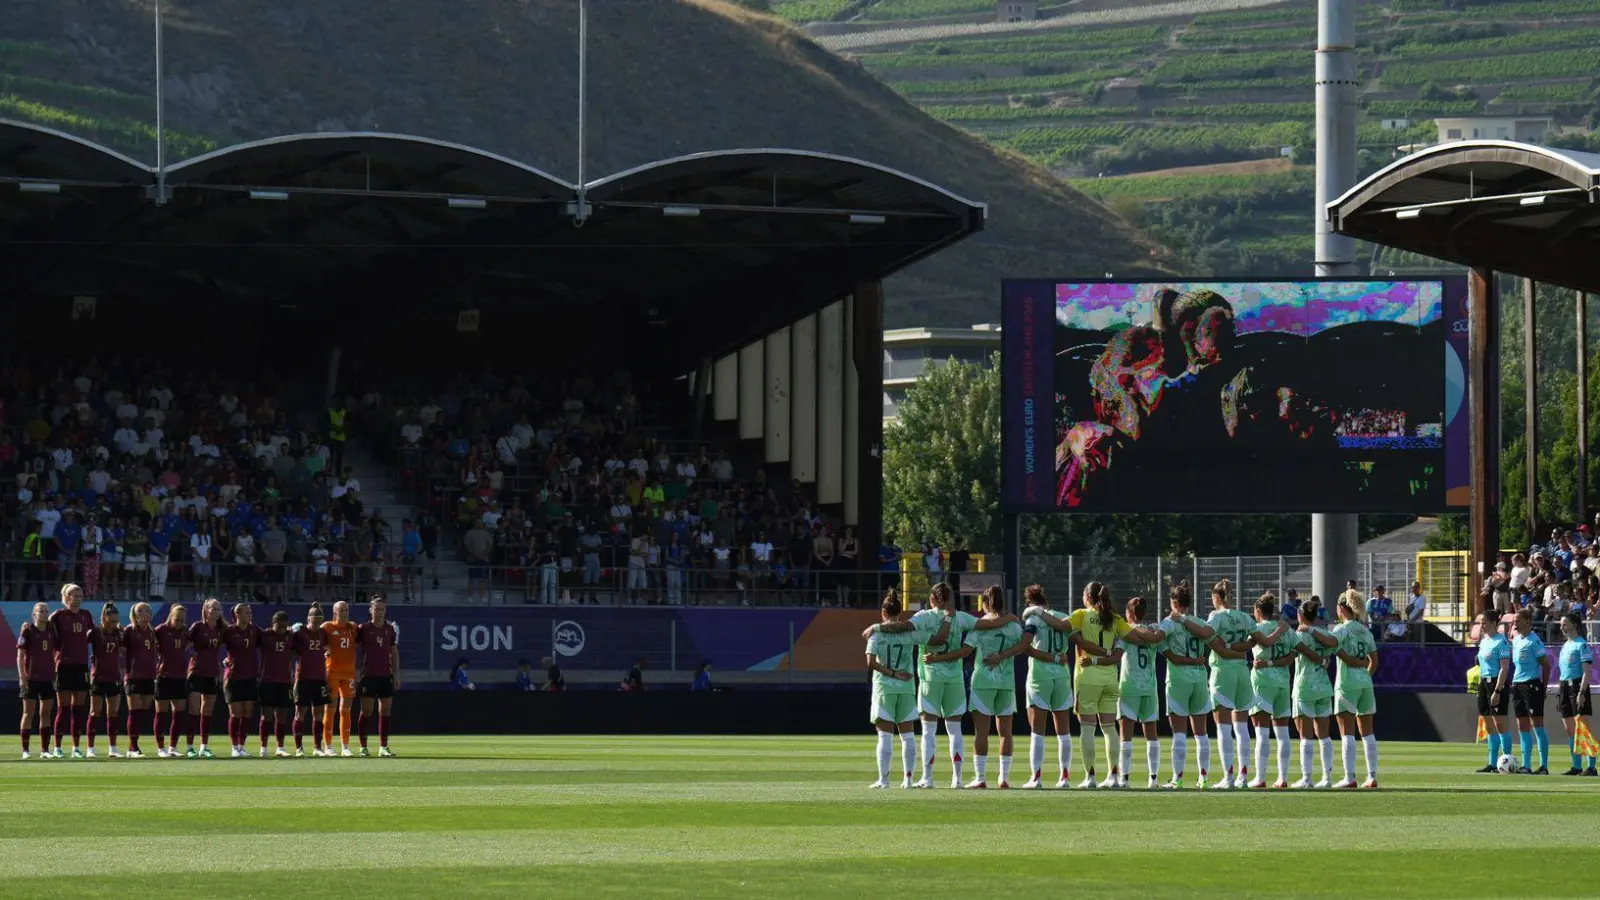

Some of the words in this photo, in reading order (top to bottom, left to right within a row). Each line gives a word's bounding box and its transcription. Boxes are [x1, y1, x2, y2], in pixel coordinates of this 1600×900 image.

[1024, 398, 1034, 425] EURO
[1024, 427, 1036, 475] WOMEN'S
[73, 622, 82, 633] 10
[145, 638, 151, 650] 9
[175, 639, 181, 649] 11
[243, 638, 250, 649] 7
[340, 637, 350, 648] 21
[377, 635, 383, 647] 4
[441, 624, 512, 651] SION
[994, 633, 1005, 654] 7
[1048, 629, 1063, 653] 10
[105, 642, 116, 653] 17
[275, 641, 285, 652] 15
[309, 640, 321, 651] 22
[1186, 636, 1199, 657] 19
[1356, 641, 1366, 660] 8
[886, 644, 904, 669] 17
[1137, 645, 1148, 669] 6
